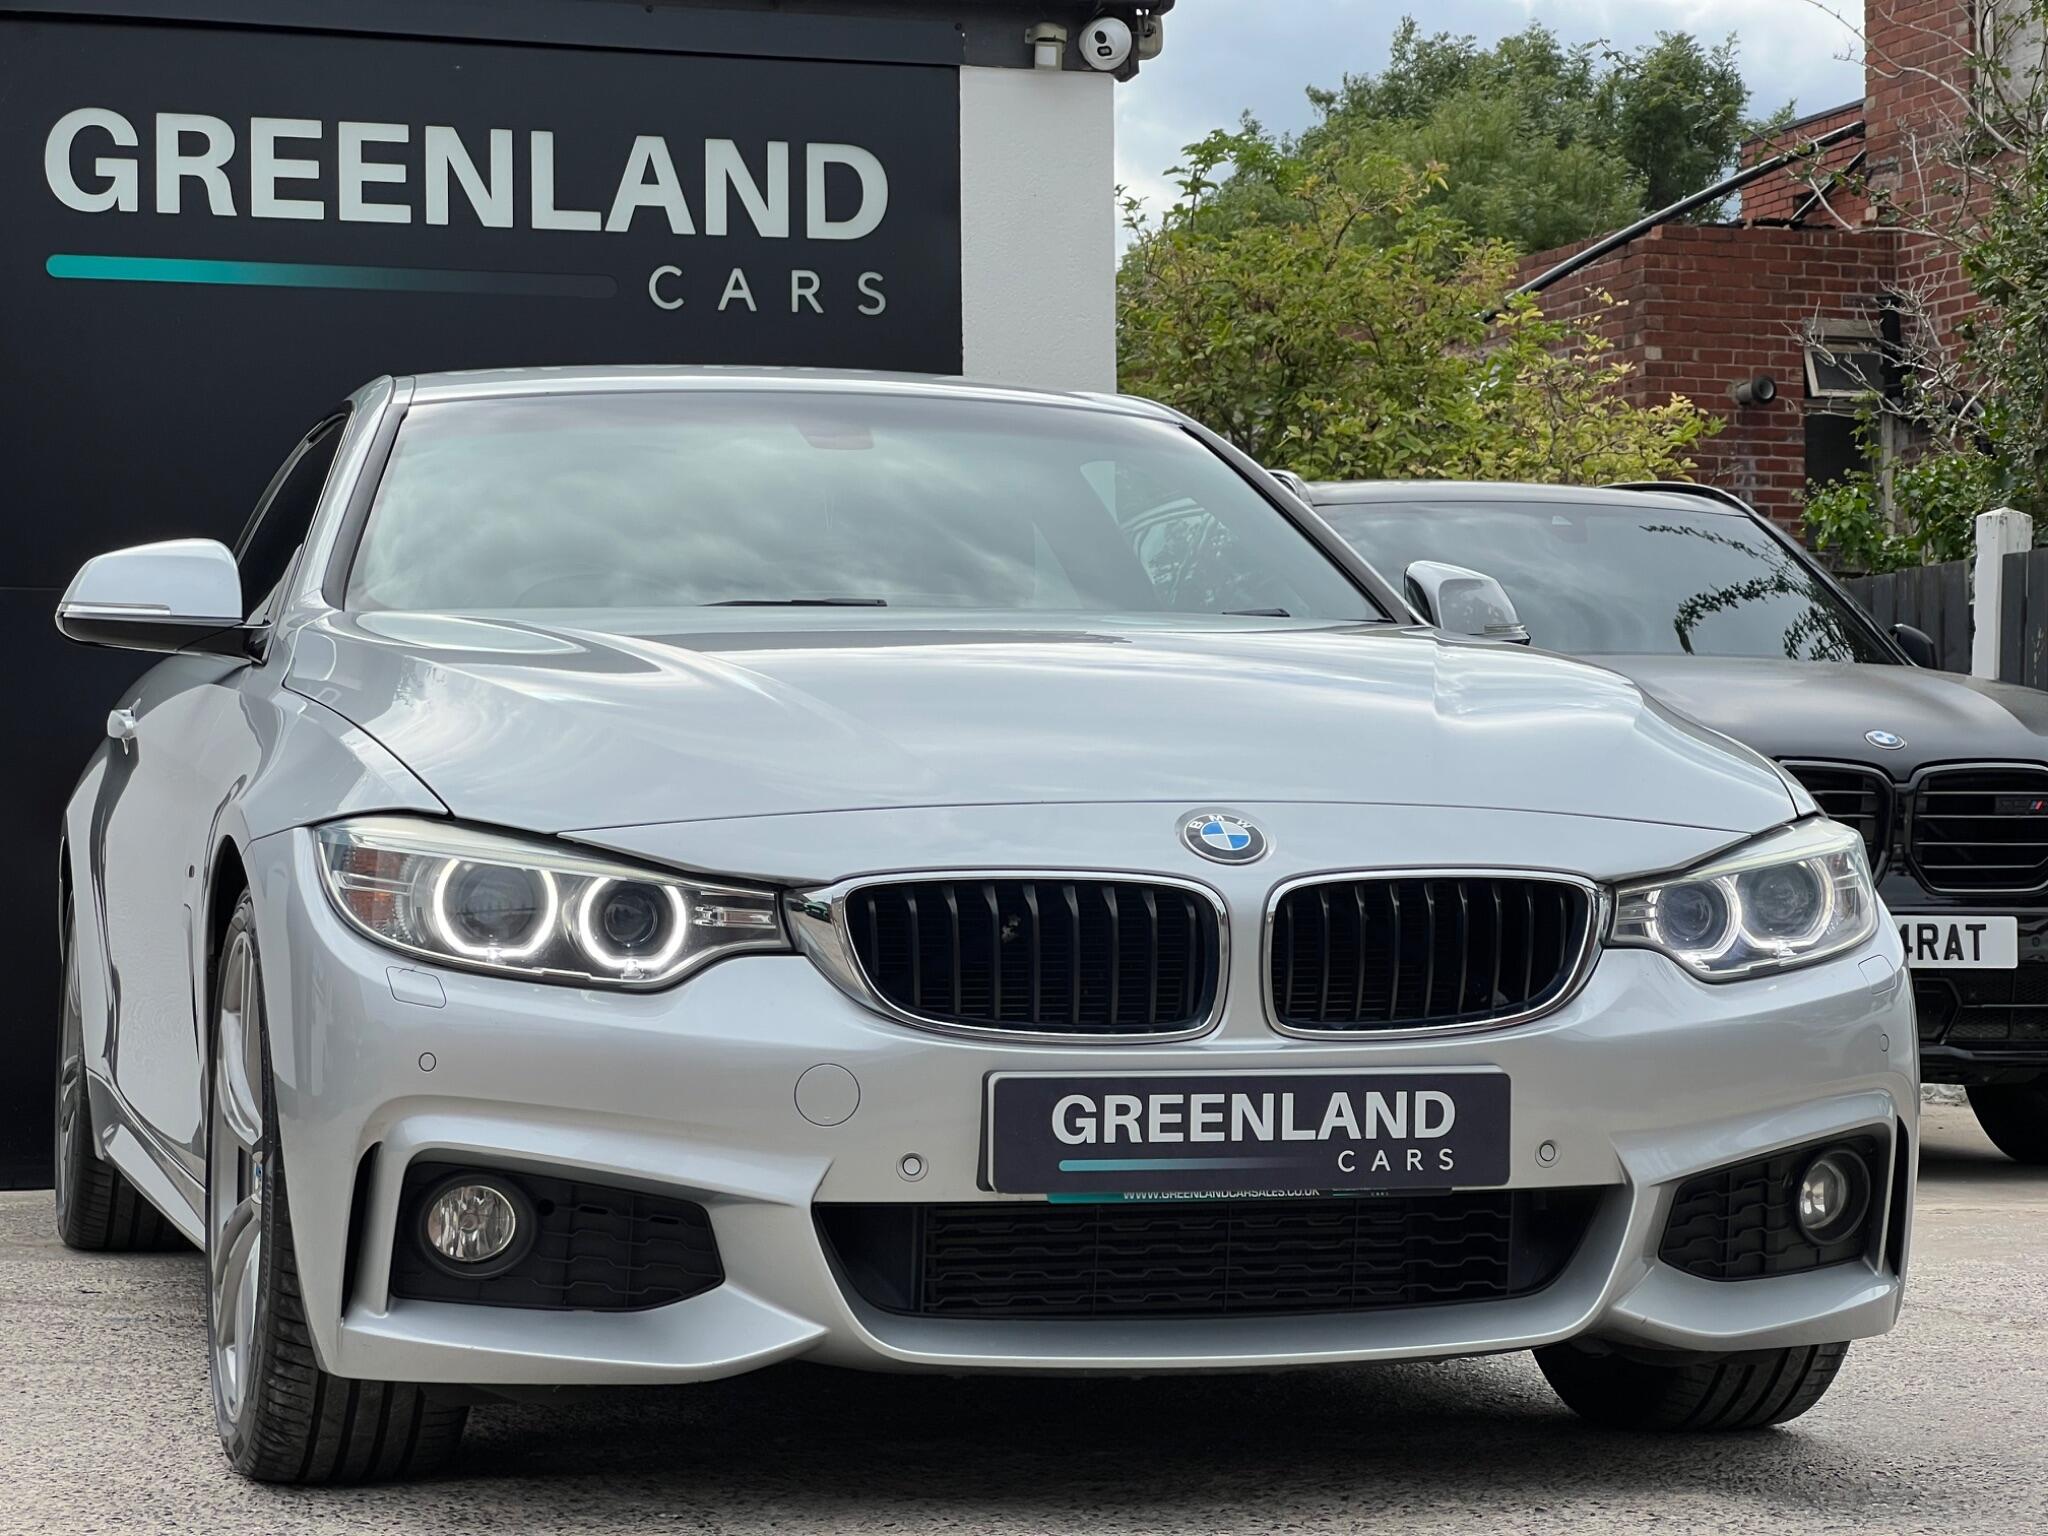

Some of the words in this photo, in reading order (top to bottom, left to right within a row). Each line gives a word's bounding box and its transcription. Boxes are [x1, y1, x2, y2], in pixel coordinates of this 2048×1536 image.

[44, 107, 889, 240] GREENLAND
[648, 265, 887, 316] CARS
[1188, 814, 1253, 829] BMW
[1051, 1090, 1456, 1145] GREENLAND
[1337, 1148, 1454, 1173] CARS
